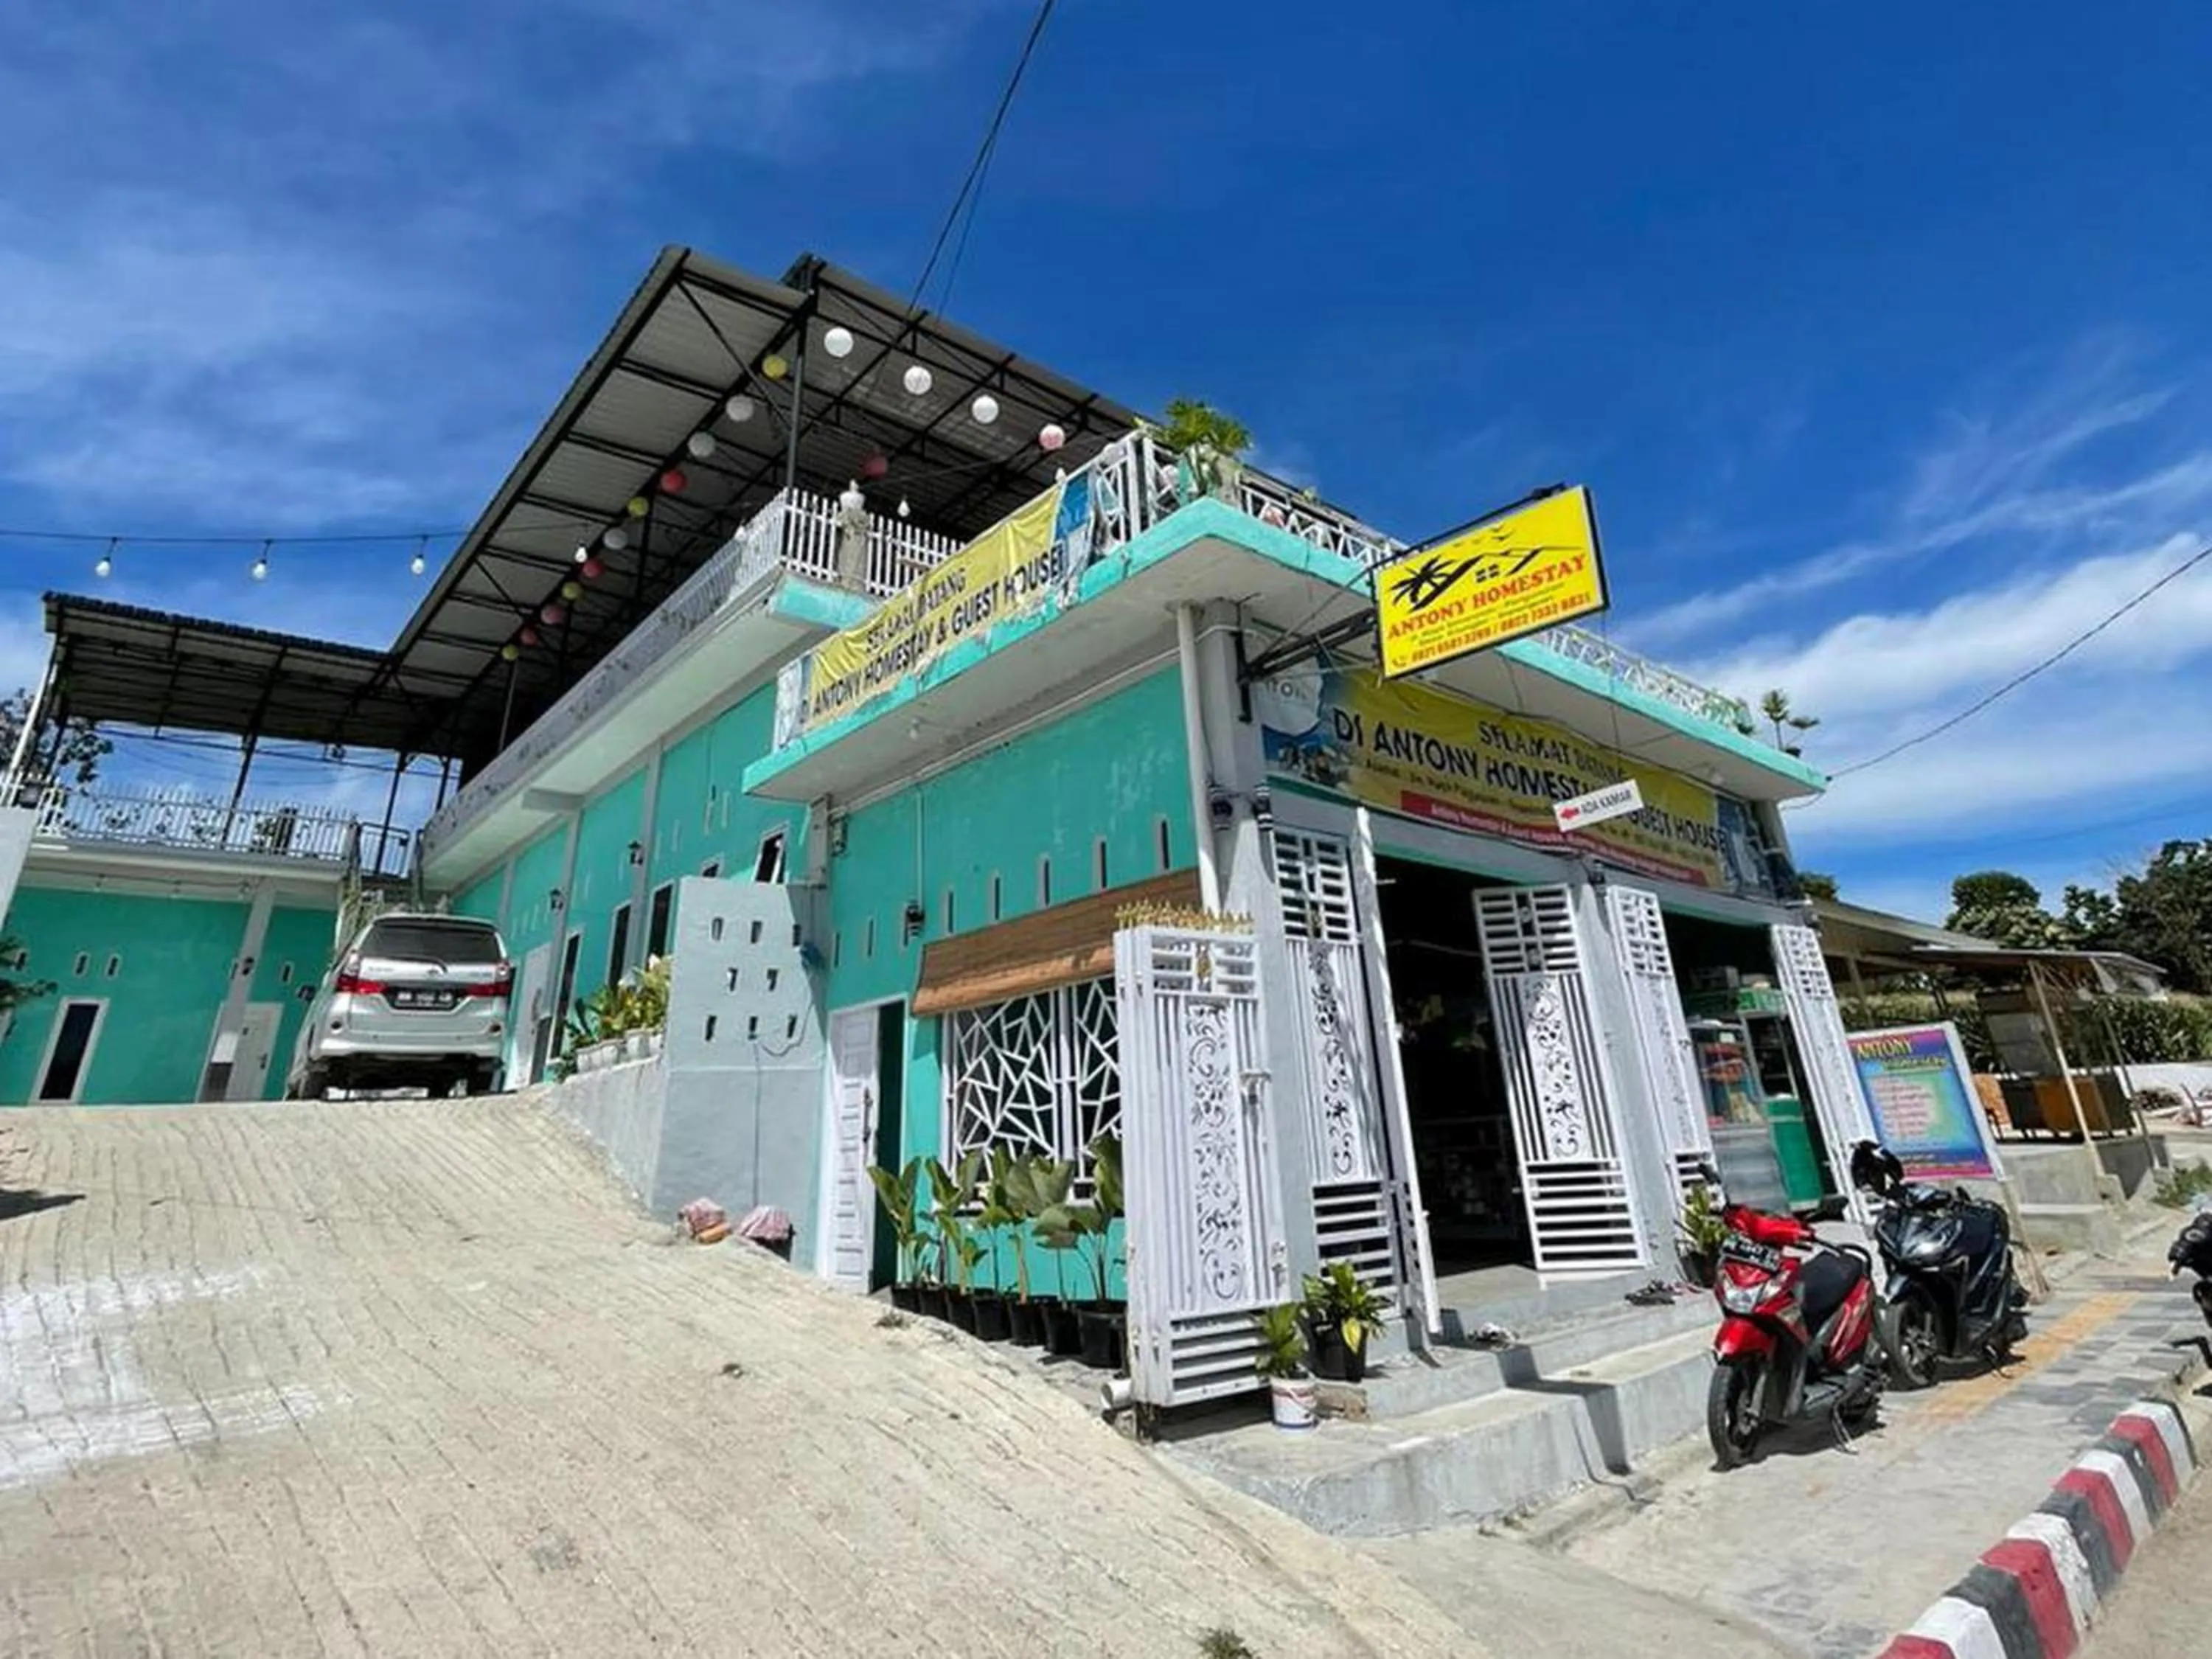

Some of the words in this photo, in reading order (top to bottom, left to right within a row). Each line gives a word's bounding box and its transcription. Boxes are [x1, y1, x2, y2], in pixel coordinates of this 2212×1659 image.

[1388, 598, 1467, 640] ANTONY
[1472, 553, 1585, 610] HOMESTAY
[813, 667, 861, 717] ANTONY
[864, 622, 933, 692] HOMESTAY
[936, 616, 947, 645] &
[951, 580, 999, 636] GUEST
[1332, 708, 1364, 748] DI
[1374, 721, 1478, 779] ANTONY
[1485, 756, 1591, 800] HOMEST
[1479, 721, 1571, 765] SELAMAT
[1600, 790, 1632, 810] KAMAR
